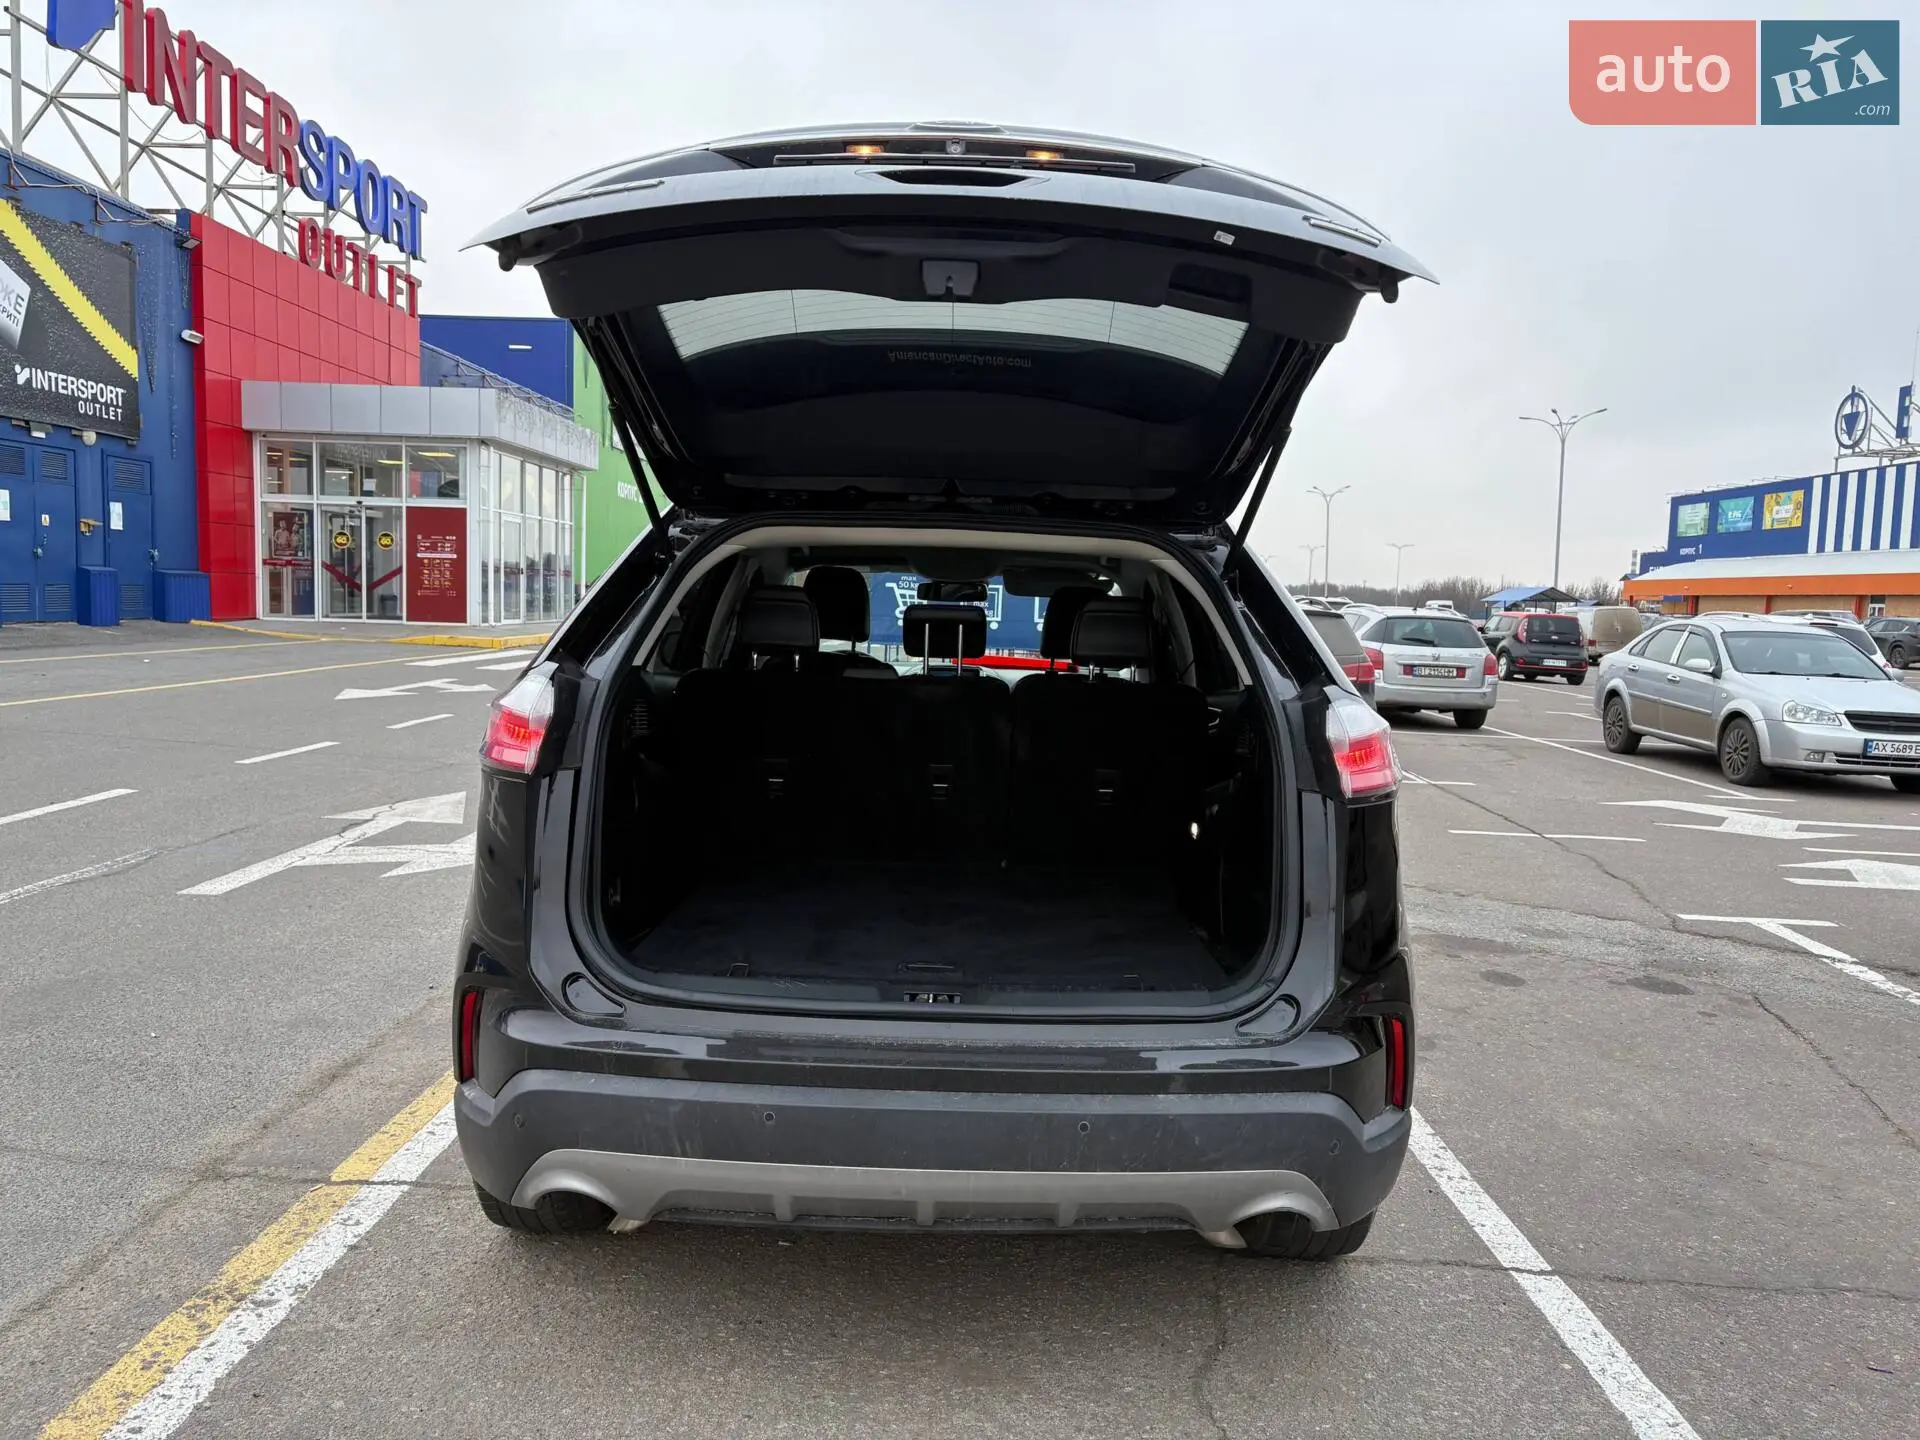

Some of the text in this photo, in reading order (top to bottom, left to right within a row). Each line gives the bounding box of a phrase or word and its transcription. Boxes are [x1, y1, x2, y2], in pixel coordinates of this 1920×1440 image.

[123, 0, 427, 260] INTERSPORT
[298, 217, 423, 318] OUTLET
[31, 367, 124, 407] INTERSPORT
[78, 401, 122, 422] OUTLET
[898, 580, 909, 589] 50
[1873, 742, 1888, 753] AX
